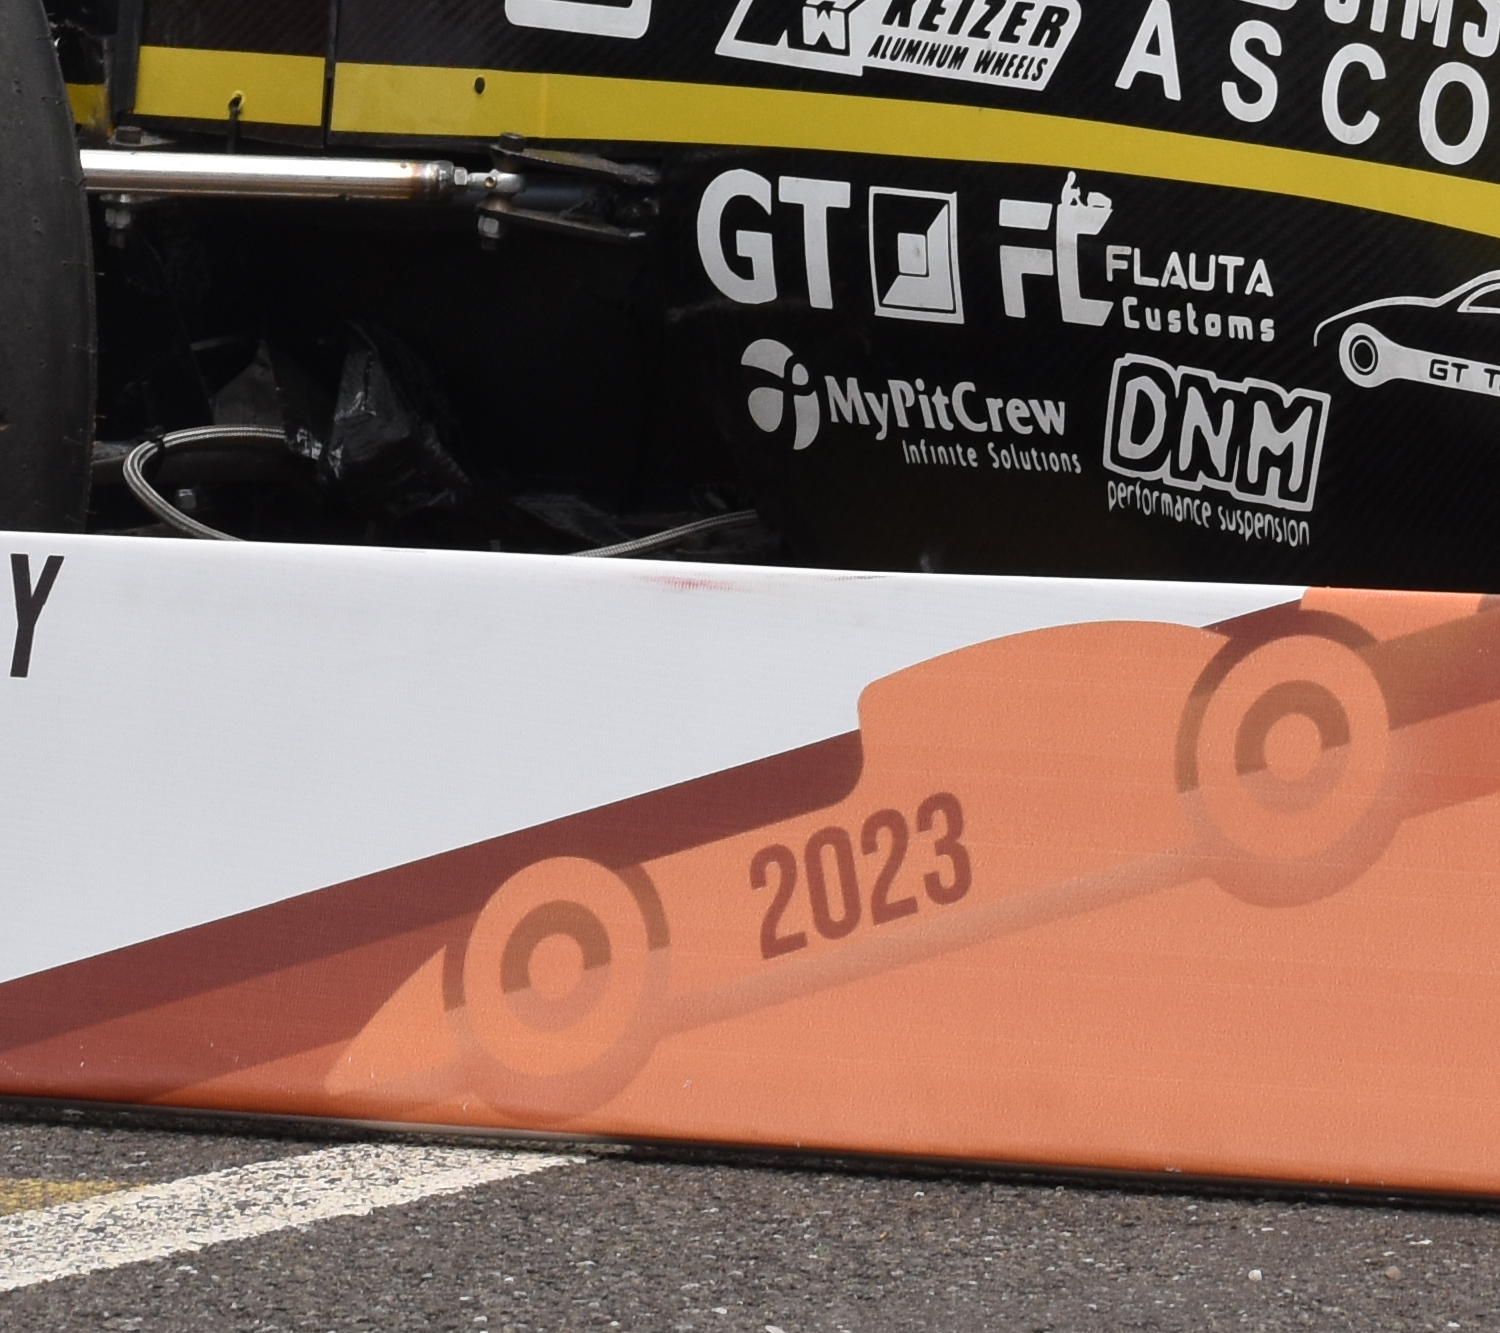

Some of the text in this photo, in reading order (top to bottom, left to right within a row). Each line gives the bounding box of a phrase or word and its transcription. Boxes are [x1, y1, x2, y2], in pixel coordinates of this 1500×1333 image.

[867, 34, 1050, 83] ALUMINUM WHEELS
[696, 167, 852, 310] GT
[1105, 244, 1275, 298] FLAUTA
[1122, 295, 1277, 343] Customs
[1427, 358, 1471, 385] GT
[823, 373, 1068, 442] MyPitCrew
[1120, 373, 1315, 497] DNM
[901, 439, 1083, 476] Infinite Solutions
[1107, 480, 1312, 549] performance suspension
[747, 790, 975, 961] 2023
